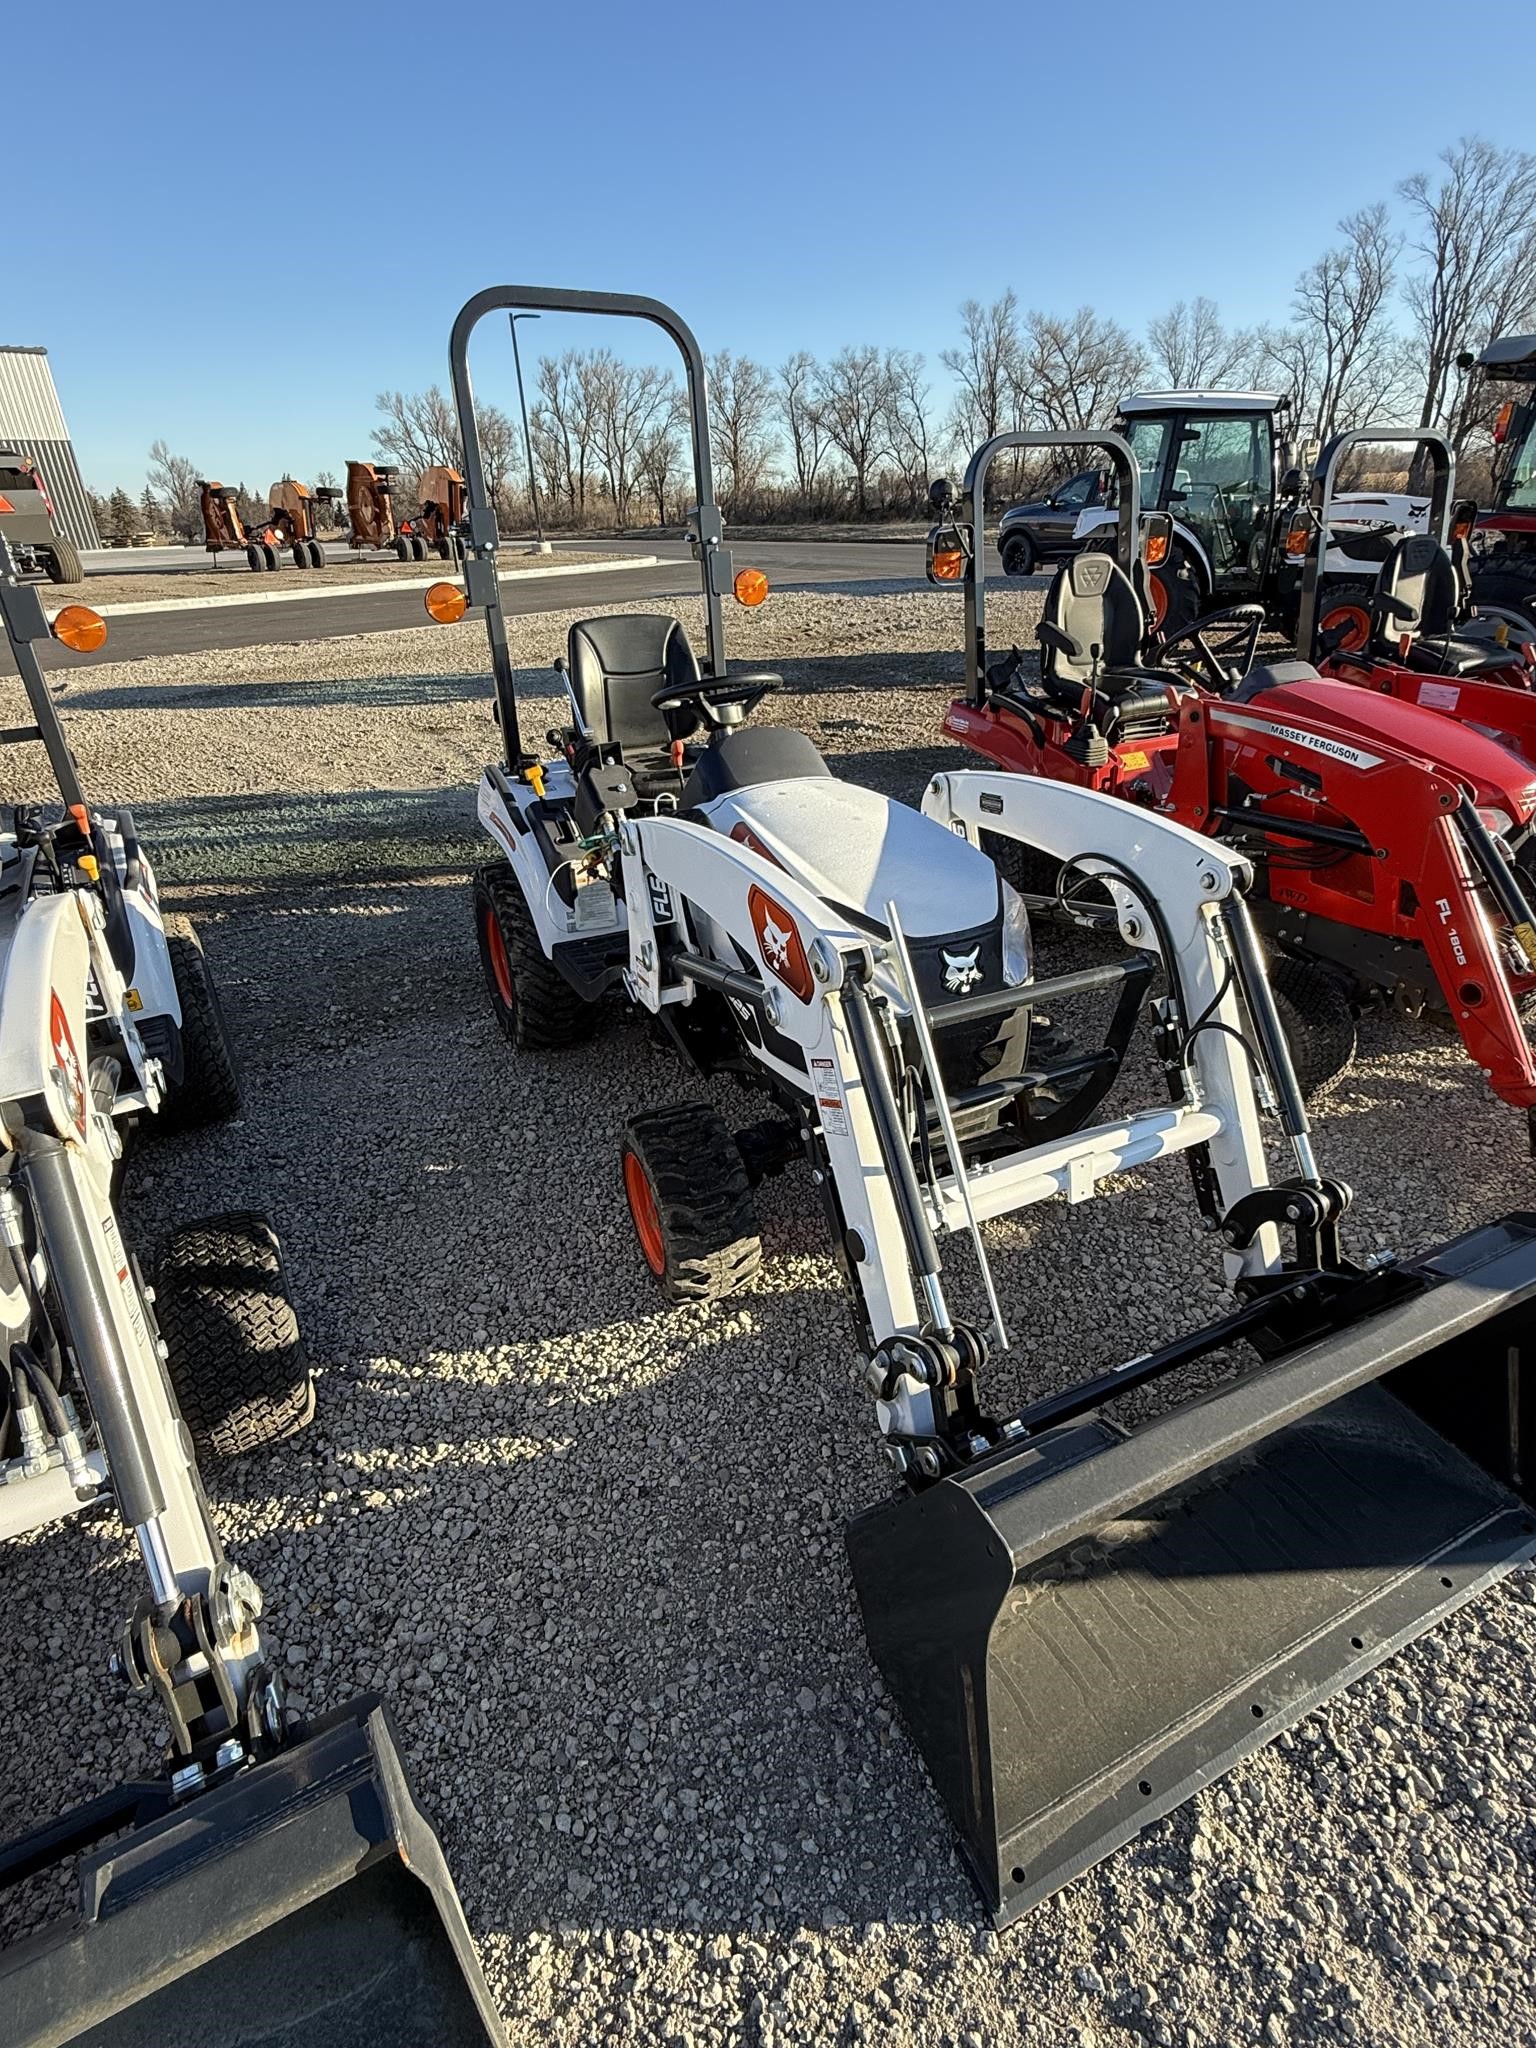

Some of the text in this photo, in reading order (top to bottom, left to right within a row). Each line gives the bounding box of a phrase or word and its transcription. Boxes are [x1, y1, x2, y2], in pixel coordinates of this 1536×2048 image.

[1270, 725, 1360, 762] MASSEY FERGUSON
[1435, 898, 1467, 966] FL 1805
